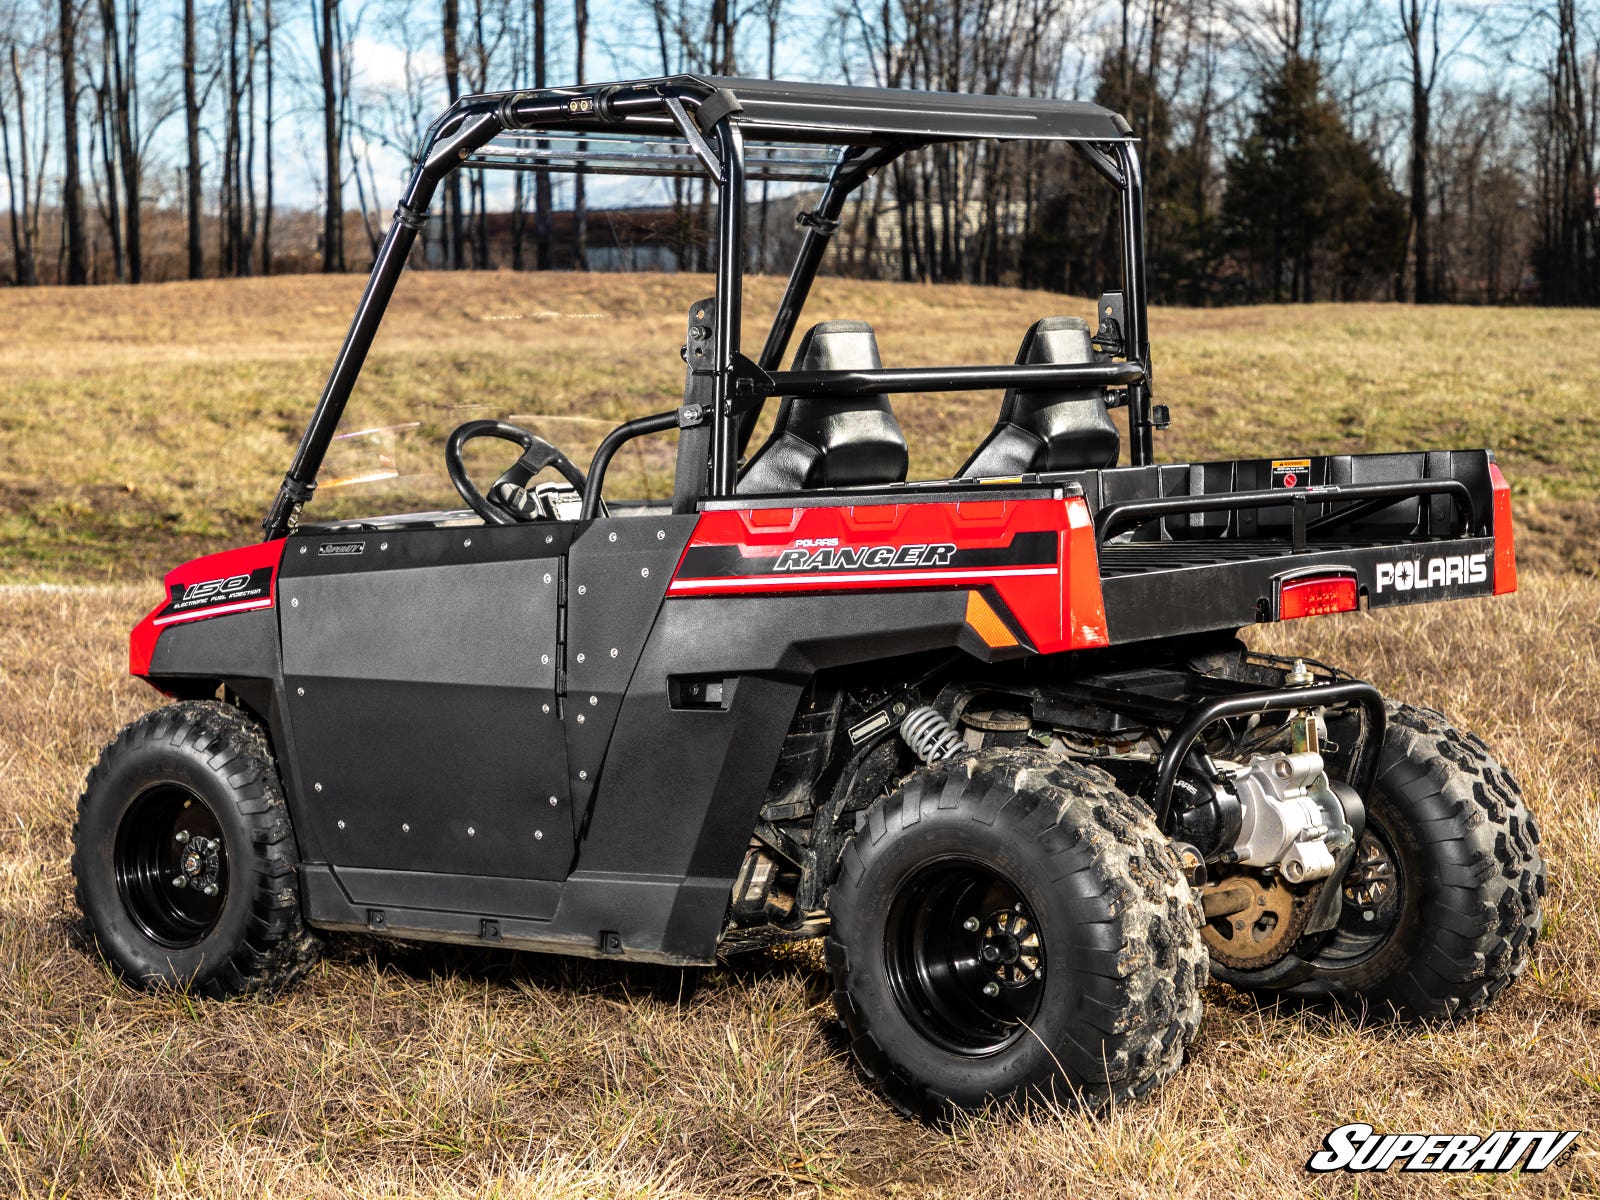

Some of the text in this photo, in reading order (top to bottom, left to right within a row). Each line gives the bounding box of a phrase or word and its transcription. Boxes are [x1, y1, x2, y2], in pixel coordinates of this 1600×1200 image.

[795, 538, 839, 548] POLARIS
[773, 543, 957, 571] RANGER
[1376, 553, 1487, 593] POLARIS
[173, 598, 209, 609] ELECTRONIC
[228, 588, 262, 599] INJECTION
[183, 574, 251, 601] 150
